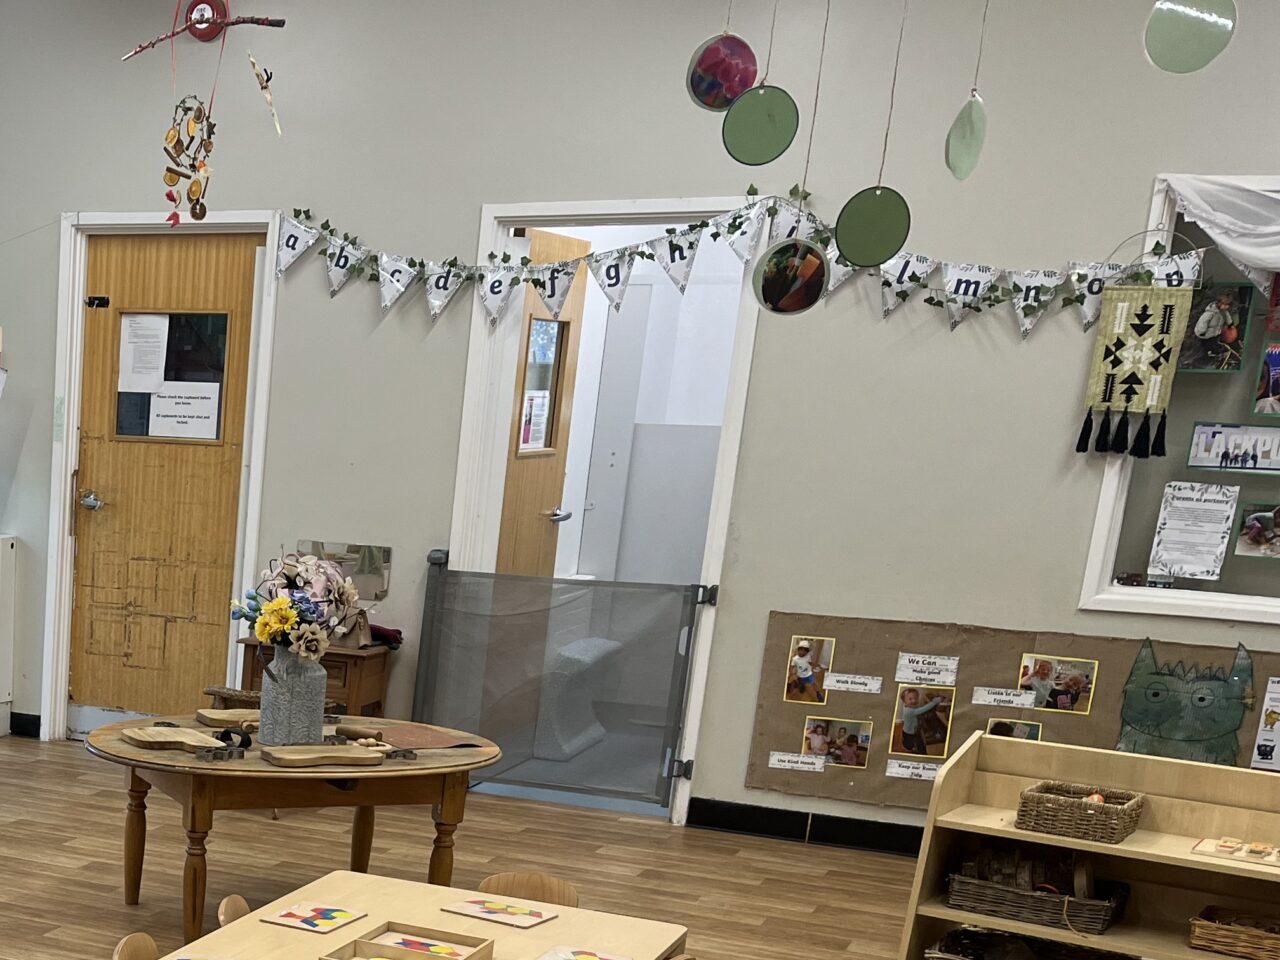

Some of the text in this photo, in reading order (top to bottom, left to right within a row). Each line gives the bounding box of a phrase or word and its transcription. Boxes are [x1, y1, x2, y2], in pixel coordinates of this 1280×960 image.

[285, 233, 299, 251] a
[334, 246, 349, 270] b
[389, 268, 403, 284] c
[434, 269, 452, 291] d
[489, 278, 503, 295] e
[547, 268, 561, 298] f
[605, 262, 621, 288] g
[668, 240, 687, 263] h
[953, 278, 981, 297] m
[1023, 285, 1041, 302] n
[1087, 278, 1105, 295] o
[908, 657, 937, 666] We Can
